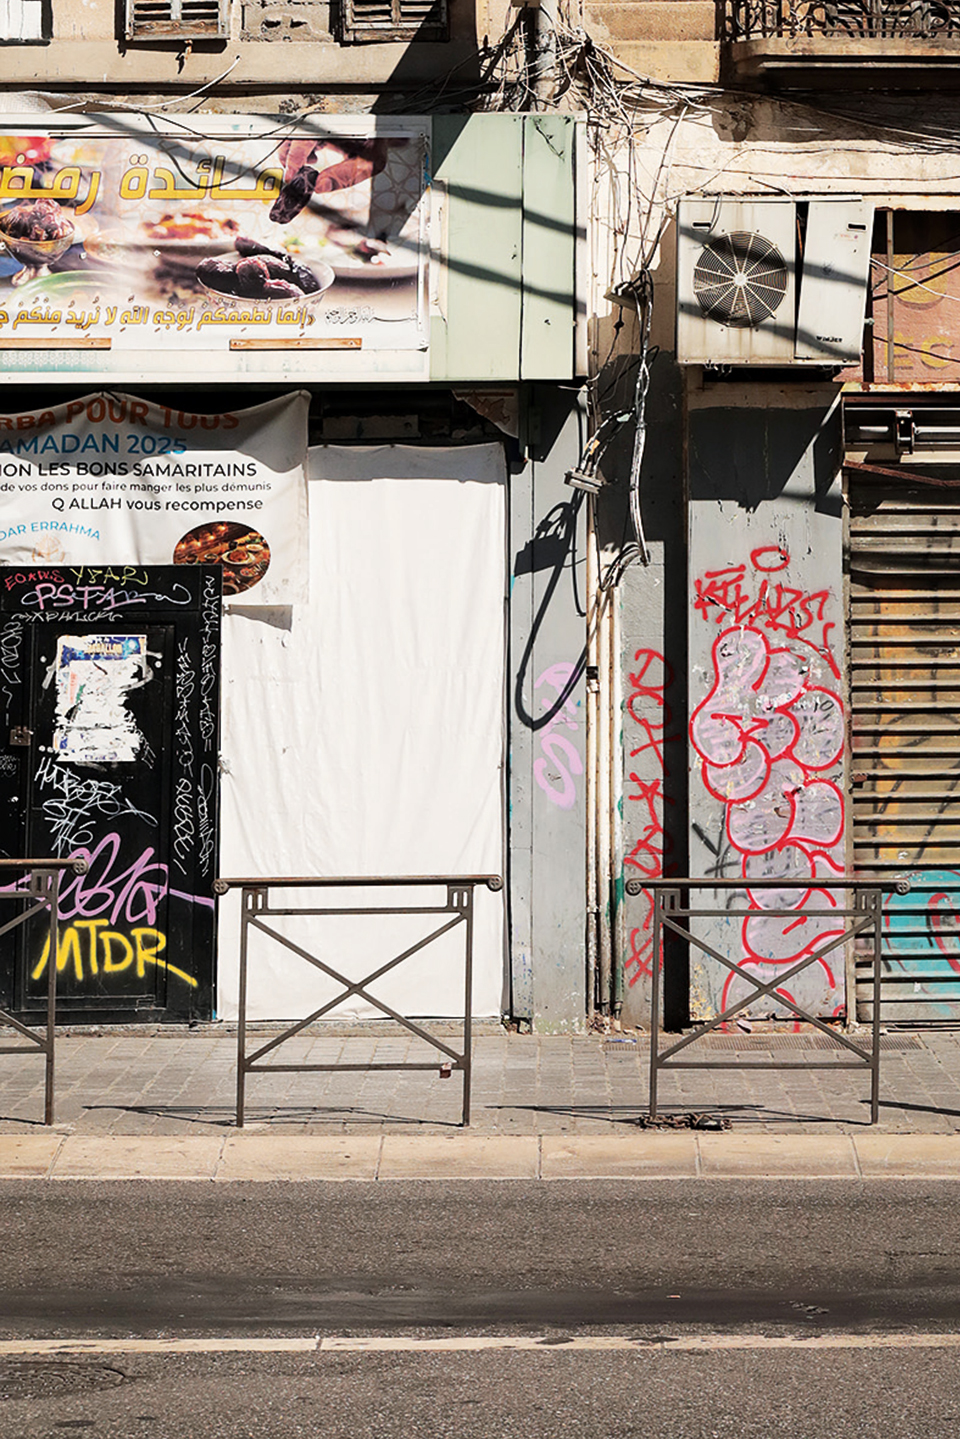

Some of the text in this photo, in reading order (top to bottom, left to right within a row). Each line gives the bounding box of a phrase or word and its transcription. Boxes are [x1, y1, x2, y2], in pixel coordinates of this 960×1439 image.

[66, 398, 149, 426] POUR
[127, 434, 188, 455] 2025
[38, 462, 71, 477] LES
[76, 462, 129, 476] BONS
[133, 462, 257, 477] SAMARITAINS
[18, 484, 38, 492] vos
[41, 482, 69, 492] dons
[72, 484, 99, 493] pour
[102, 481, 127, 492] faire
[130, 483, 172, 495] manger
[175, 482, 191, 492] les
[194, 483, 219, 494] plus
[52, 497, 263, 514] Q ALLAH vous recompense
